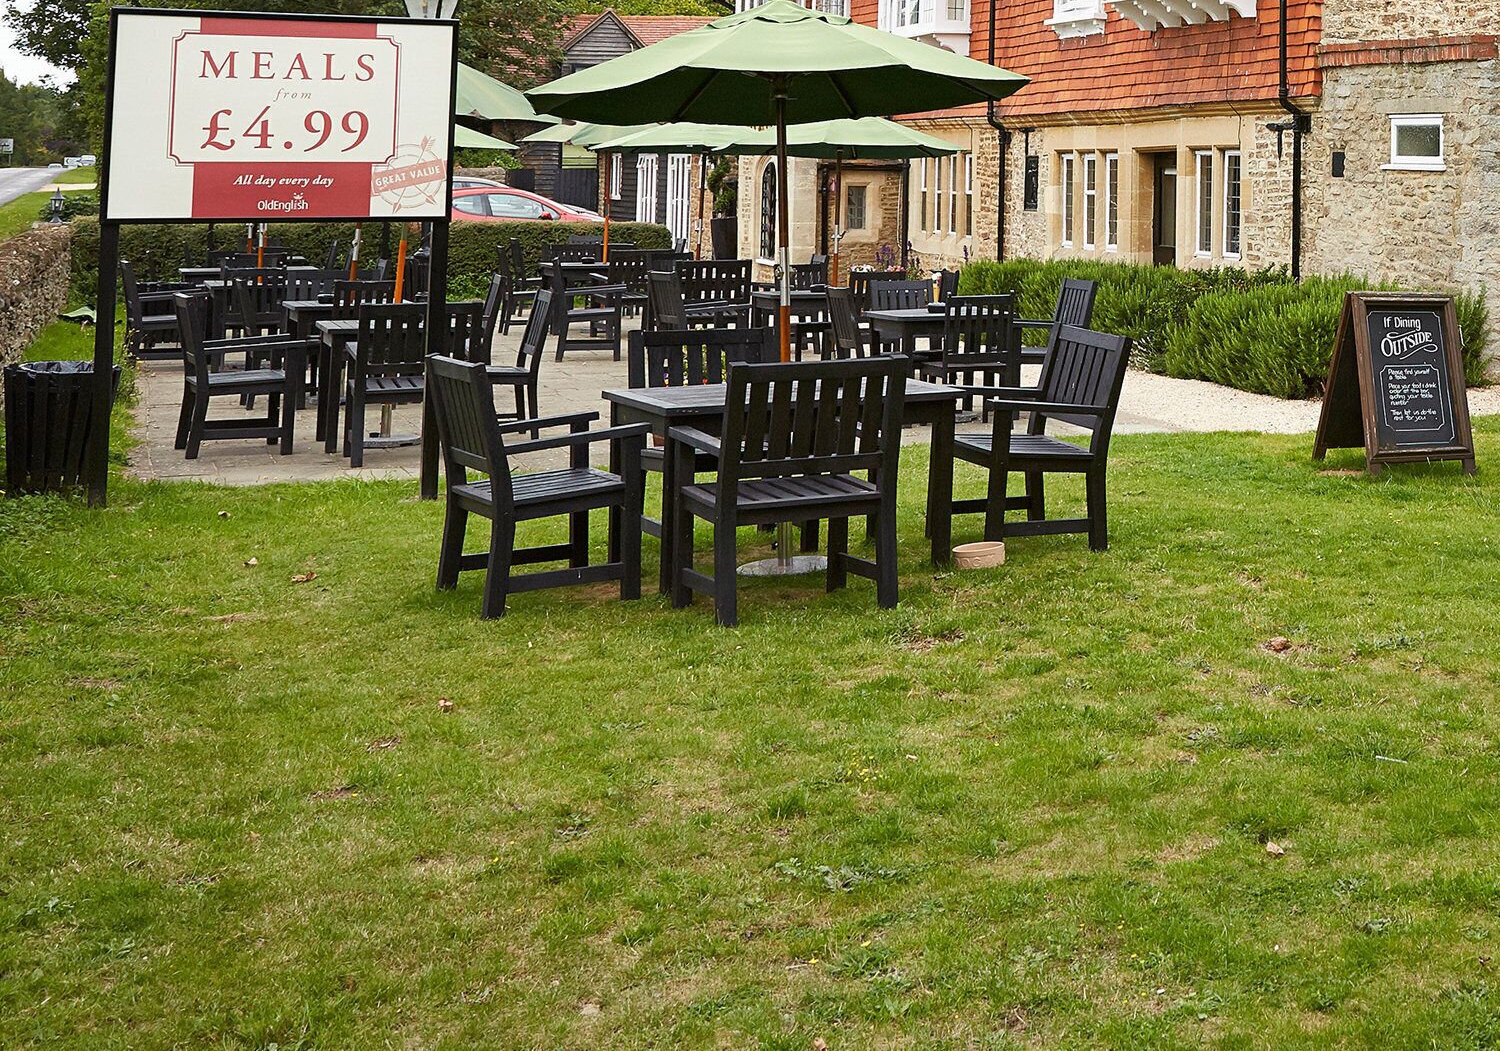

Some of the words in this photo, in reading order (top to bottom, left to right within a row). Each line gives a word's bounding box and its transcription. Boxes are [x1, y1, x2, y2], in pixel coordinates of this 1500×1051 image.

[198, 50, 375, 82] MEALS
[273, 88, 312, 103] from
[200, 105, 370, 153] £4.99
[233, 175, 252, 186] All
[255, 175, 277, 188] day
[278, 177, 310, 188] every
[312, 175, 334, 188] day
[375, 172, 407, 187] GREAT
[409, 165, 441, 179] VALUE
[257, 199, 309, 213] OldEnglish
[1383, 316, 1392, 328] If
[1394, 316, 1421, 331] Dining
[1381, 331, 1433, 357] OUTSIDE
